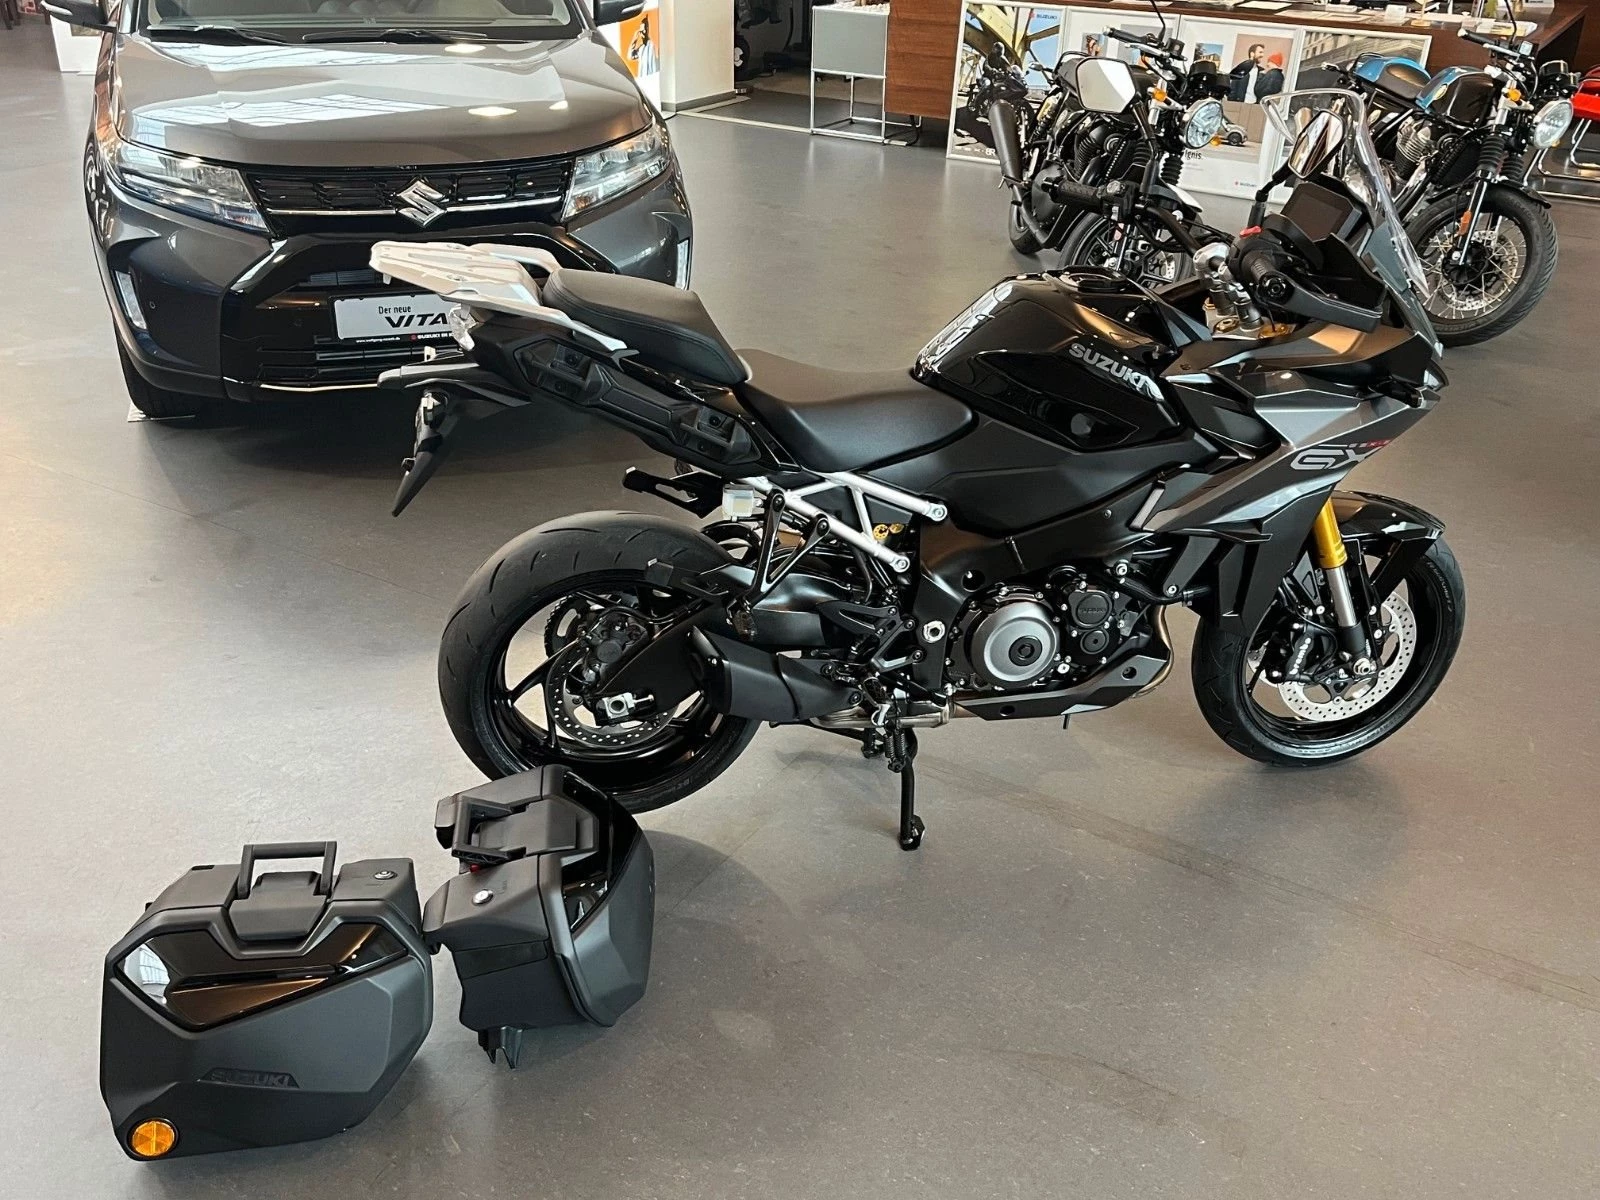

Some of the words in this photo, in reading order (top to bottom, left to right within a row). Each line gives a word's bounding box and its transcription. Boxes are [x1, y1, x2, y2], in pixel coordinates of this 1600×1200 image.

[378, 306, 392, 315] Der
[393, 305, 411, 314] neue
[385, 312, 448, 328] VITA
[1068, 342, 1147, 389] SUZUKI
